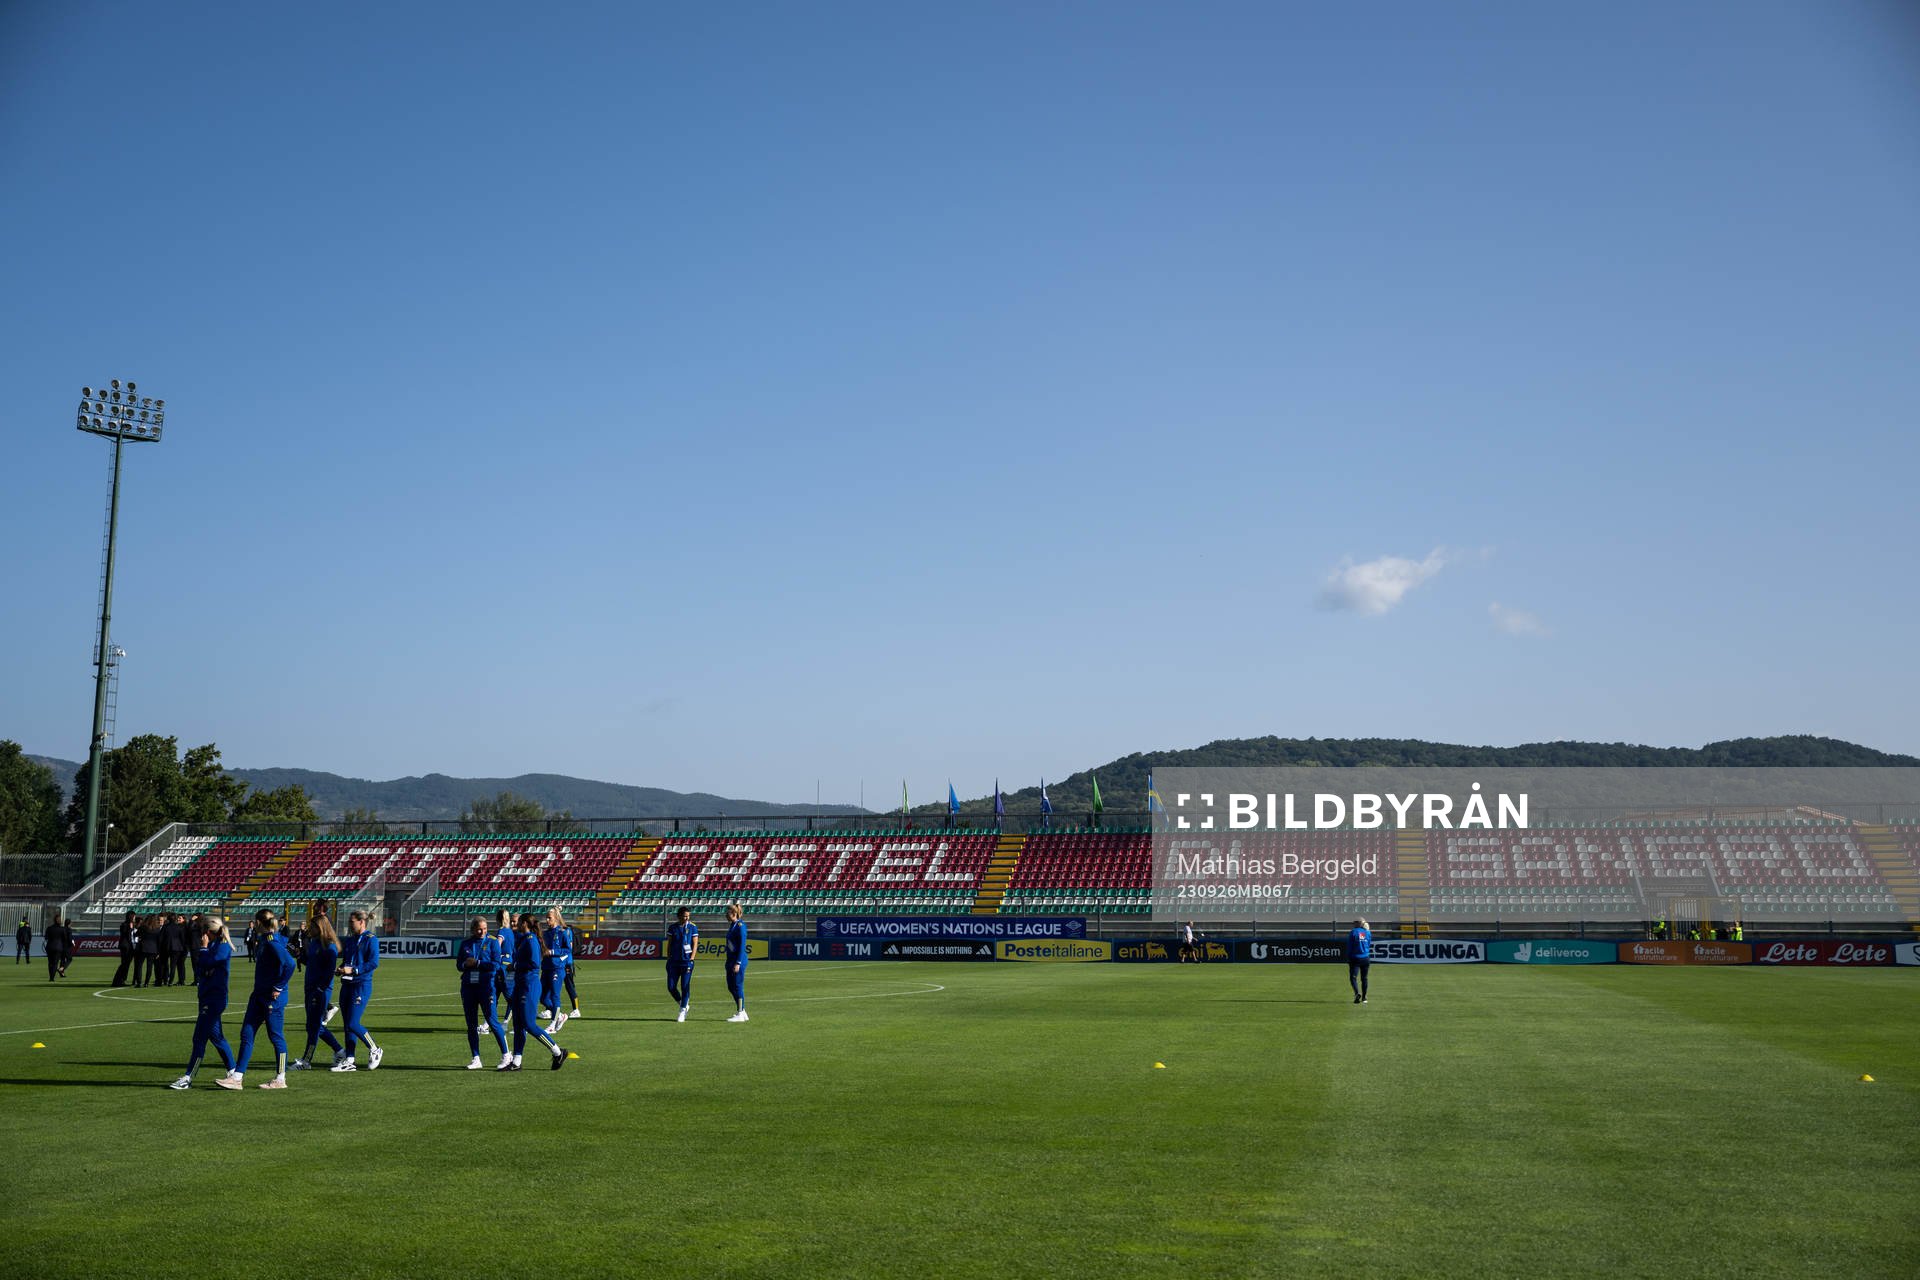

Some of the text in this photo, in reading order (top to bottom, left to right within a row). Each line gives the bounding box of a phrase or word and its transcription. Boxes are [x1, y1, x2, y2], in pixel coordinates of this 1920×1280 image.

[640, 842, 975, 883] CASTEL
[840, 923, 873, 935] UEFA
[875, 922, 940, 935] WOMEN'S
[942, 923, 1004, 935] NATIONS
[1007, 923, 1062, 935] LEAGUE
[380, 941, 448, 955] SELUNGA
[580, 940, 604, 955] ete
[611, 940, 656, 957] Lete
[794, 943, 820, 956] TIM
[846, 943, 871, 956] TIM
[902, 946, 973, 955] IMPOSSIBLE IS NOTHING
[1118, 944, 1144, 959] eni
[1271, 946, 1341, 959] TeamSystem
[1535, 946, 1590, 958] deliveroo
[1759, 943, 1818, 962] Lete
[1828, 943, 1888, 963] Lete
